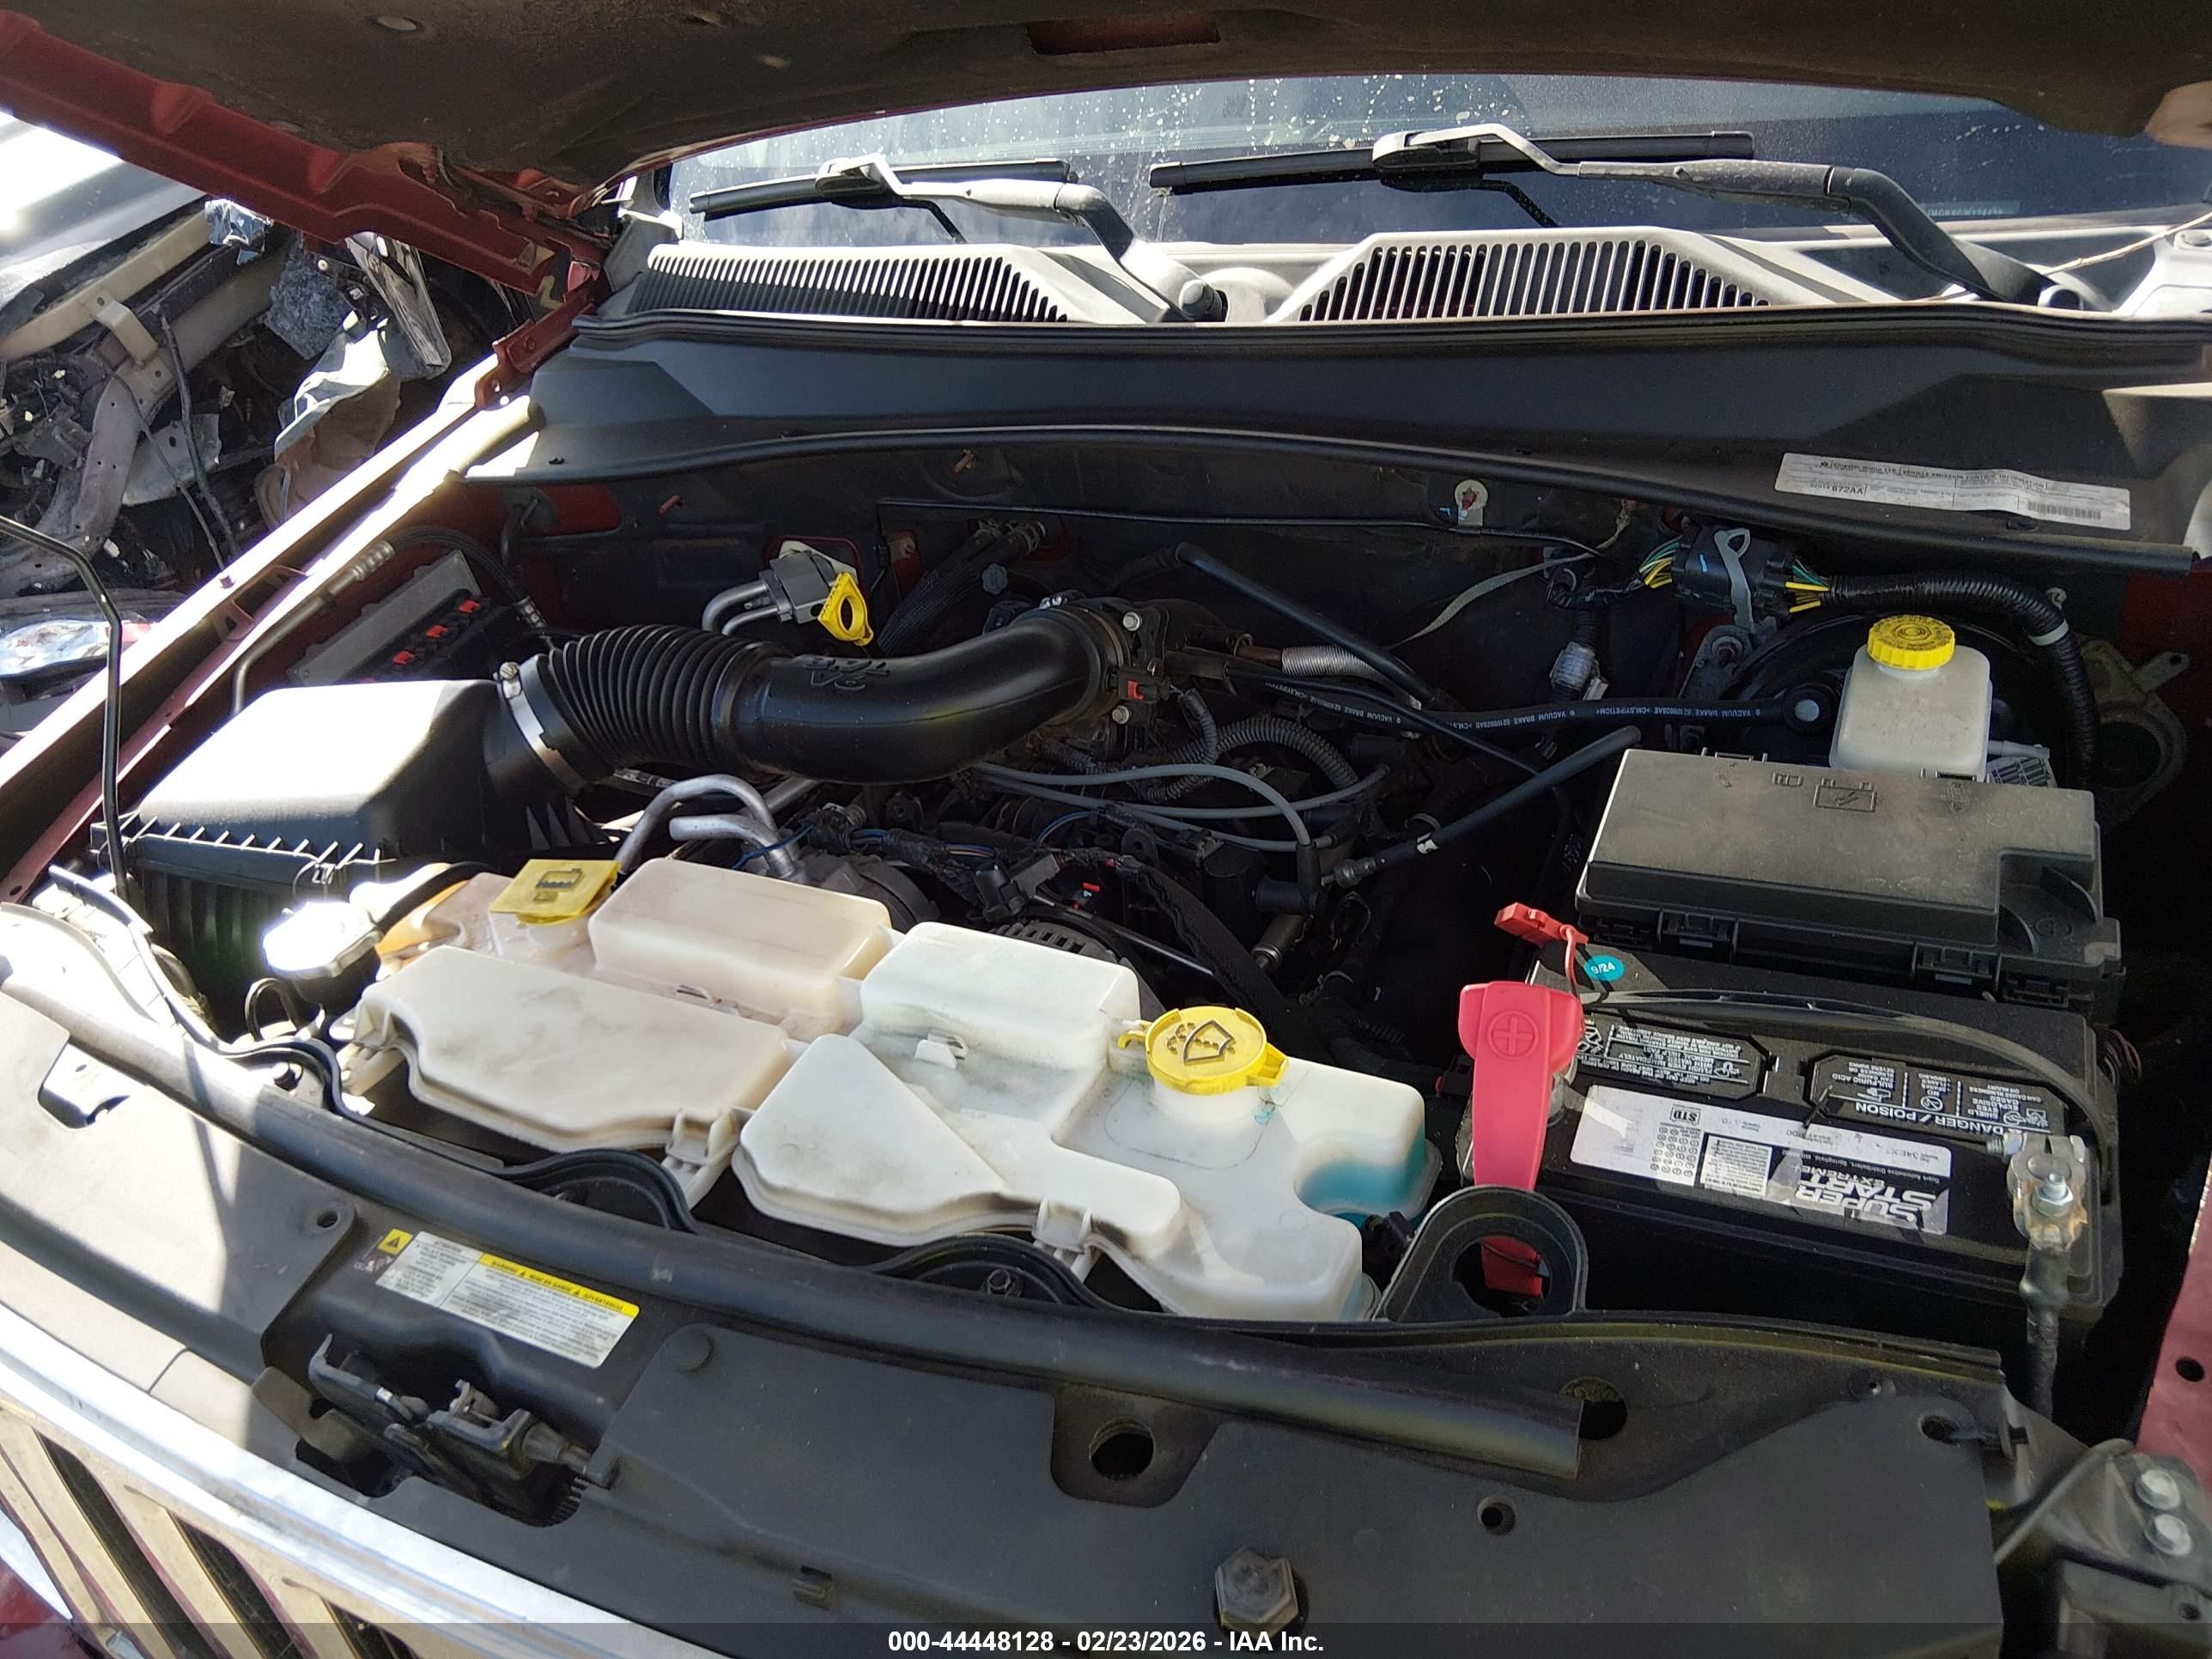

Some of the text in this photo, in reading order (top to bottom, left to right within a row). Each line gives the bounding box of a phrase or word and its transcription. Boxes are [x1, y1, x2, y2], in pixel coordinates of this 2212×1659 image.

[1343, 705, 1364, 717] BRAKE
[1366, 710, 1393, 723] VACUUM
[1537, 709, 1565, 721] VACUUM
[1513, 714, 1535, 725] BRAKE
[1590, 962, 1615, 974] 9/24
[1618, 1052, 1665, 1066] IMMEDIATELY
[1831, 1073, 1893, 1088] SULFURIC ACID
[1971, 1097, 2019, 1110] EXPLOSIVE
[1989, 1095, 2019, 1105] GASES
[1673, 1109, 1697, 1121] STD
[1855, 1103, 1917, 1119] POISON
[1966, 1109, 1998, 1119] SHIELD
[1935, 1116, 2004, 1134] DANGER
[1886, 1168, 1921, 1180] Automotive
[1800, 1175, 1936, 1211] START
[1795, 1186, 1917, 1222] SUPER
